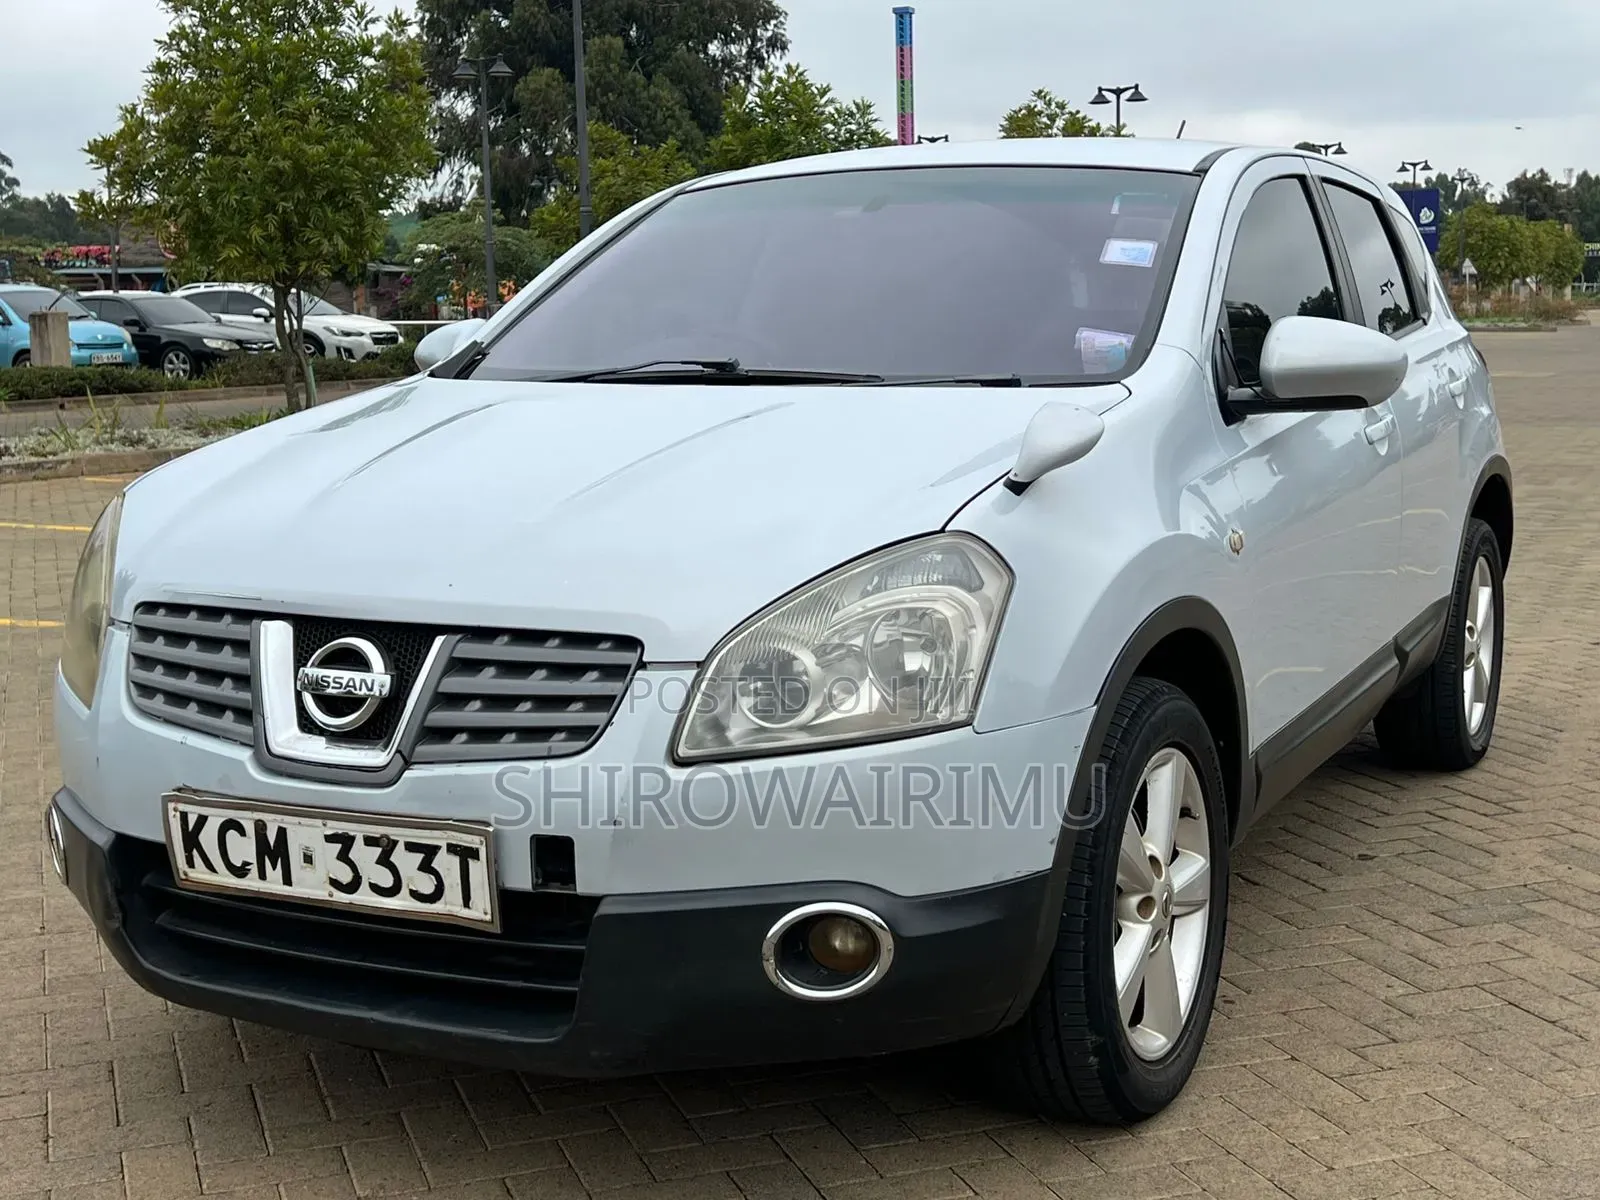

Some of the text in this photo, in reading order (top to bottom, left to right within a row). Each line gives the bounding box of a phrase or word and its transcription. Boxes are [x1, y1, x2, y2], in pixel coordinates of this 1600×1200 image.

[302, 672, 376, 692] NISSAN
[179, 810, 481, 909] KCM 333T
